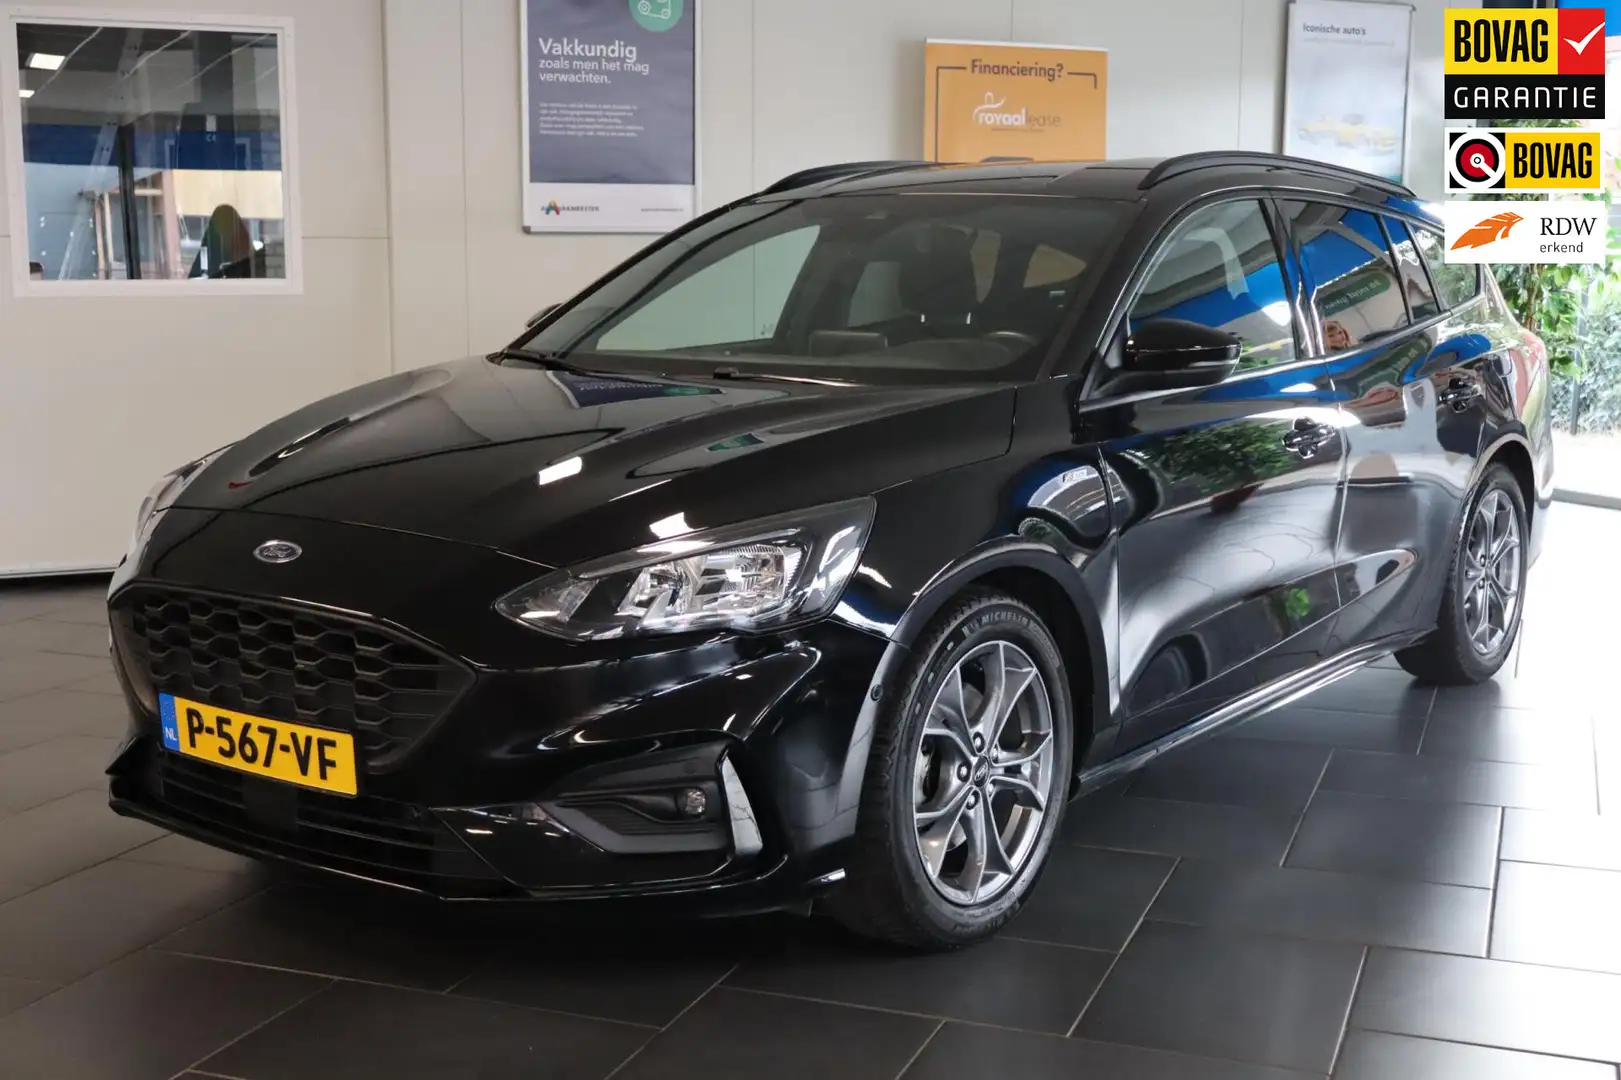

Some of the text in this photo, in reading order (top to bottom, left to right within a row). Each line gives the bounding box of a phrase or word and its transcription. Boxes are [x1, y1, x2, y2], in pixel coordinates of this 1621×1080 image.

[1302, 22, 1367, 36] Iconische auto's
[538, 37, 637, 63] Vakkundig
[538, 57, 650, 76] zoals men het mag
[971, 59, 1064, 83] Financiering?
[539, 70, 612, 84] verwachten.
[981, 611, 1030, 626] MICHELIN
[164, 727, 178, 742] NL
[185, 707, 337, 781] P-567-VF
